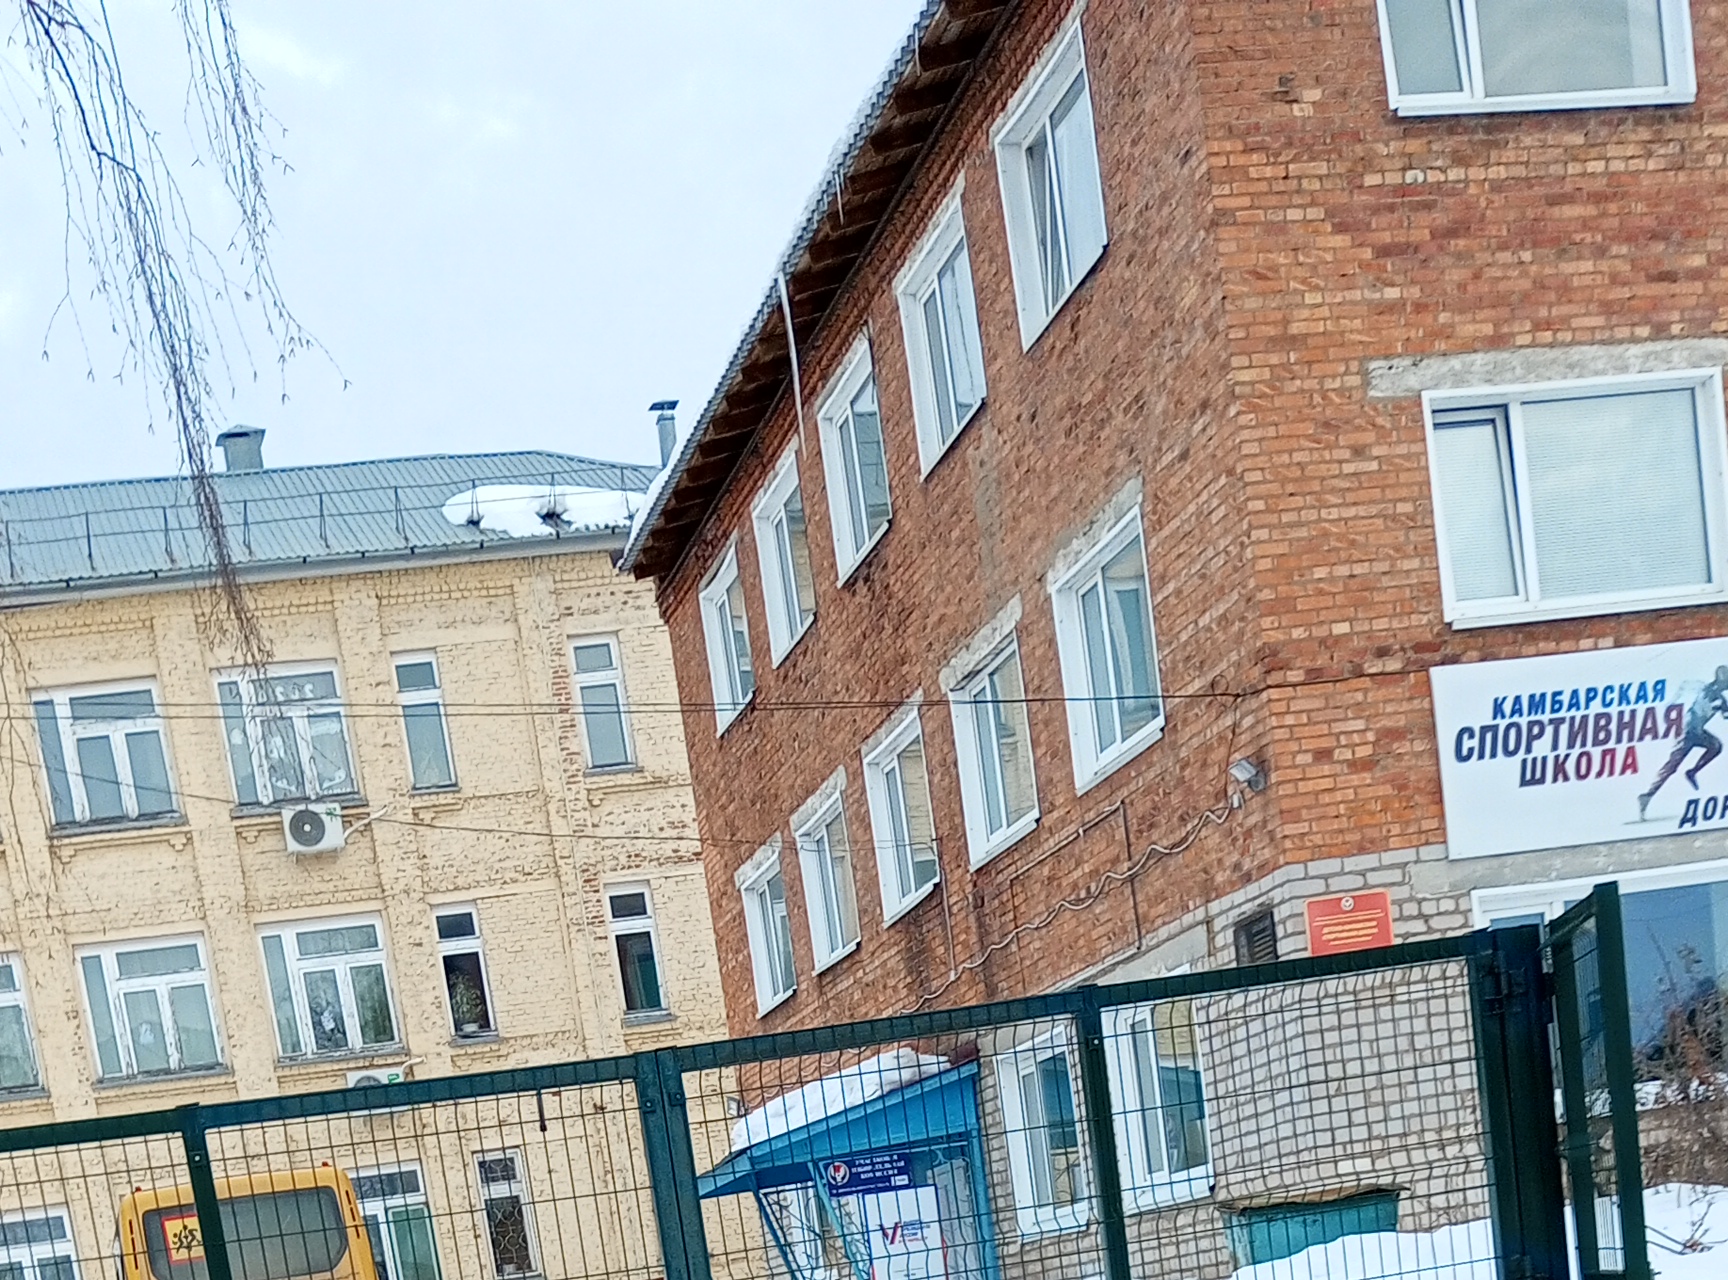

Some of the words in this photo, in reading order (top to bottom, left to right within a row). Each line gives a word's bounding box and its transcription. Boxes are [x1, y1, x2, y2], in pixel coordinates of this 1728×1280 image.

[1492, 679, 1666, 721] КАМБАРСКАЯ
[1454, 703, 1685, 763] СПОРТИВНАЯ
[1519, 745, 1640, 788] ШКОЛА
